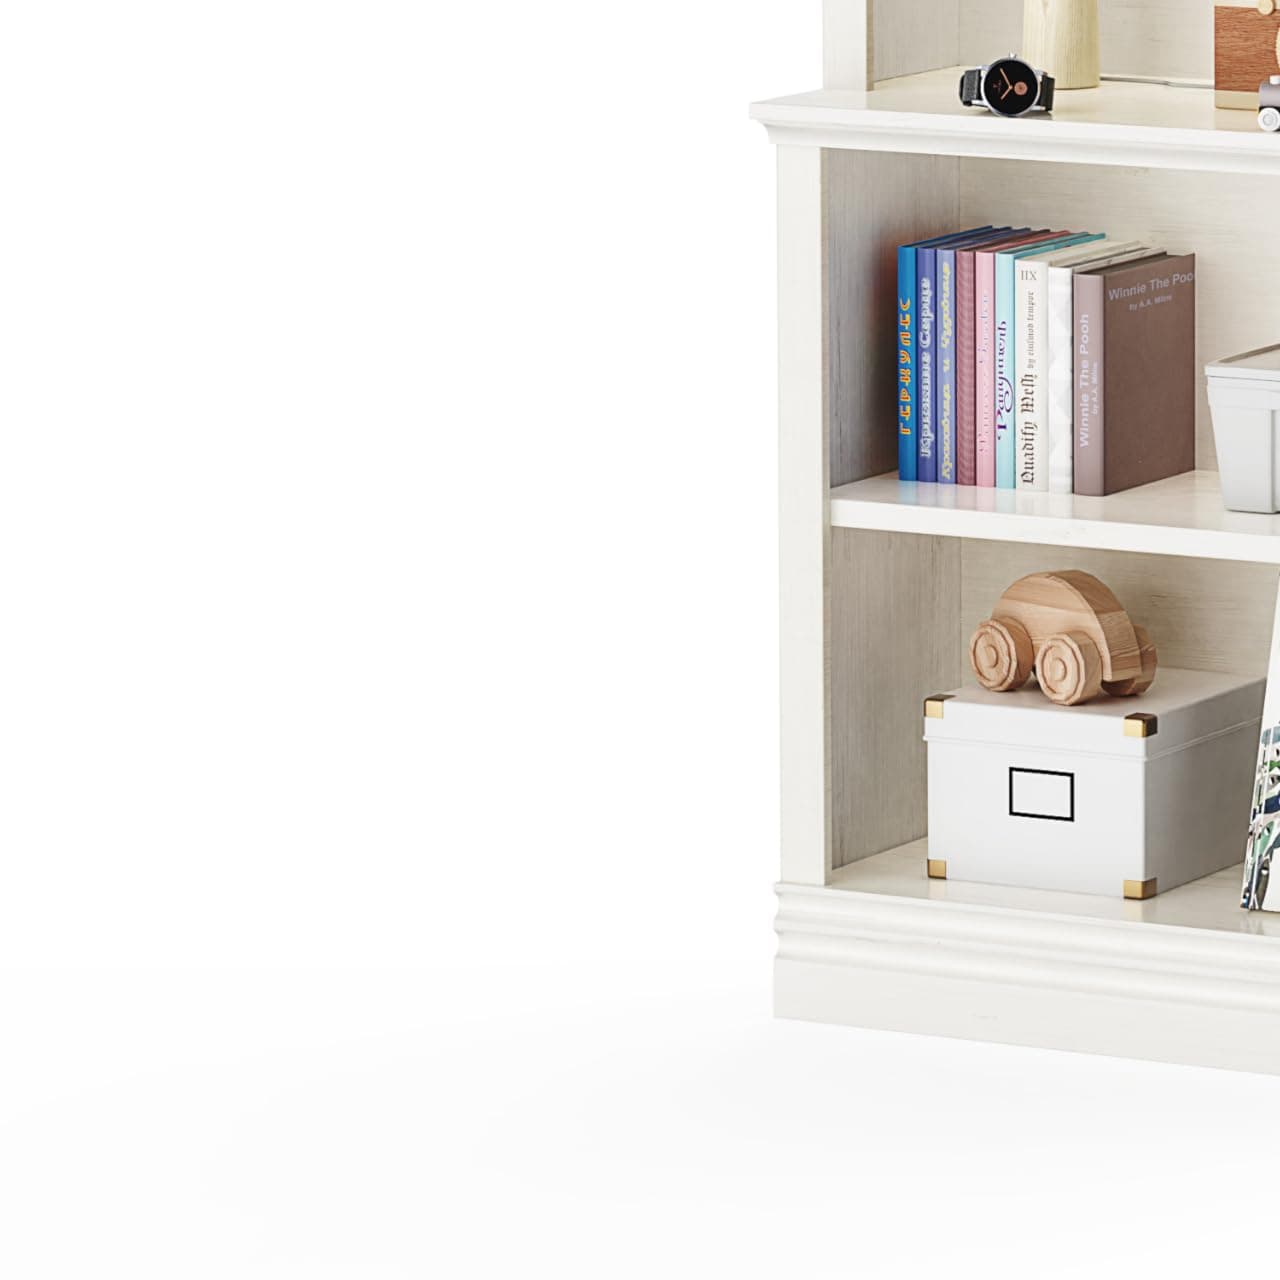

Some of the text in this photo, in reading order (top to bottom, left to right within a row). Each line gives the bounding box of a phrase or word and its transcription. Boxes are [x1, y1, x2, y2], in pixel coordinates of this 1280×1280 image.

[1109, 282, 1146, 301] Winnie
[1151, 277, 1170, 291] The
[900, 297, 912, 435] ГЕРКУЛЕС
[1080, 314, 1089, 448] Winnie The Pooh
